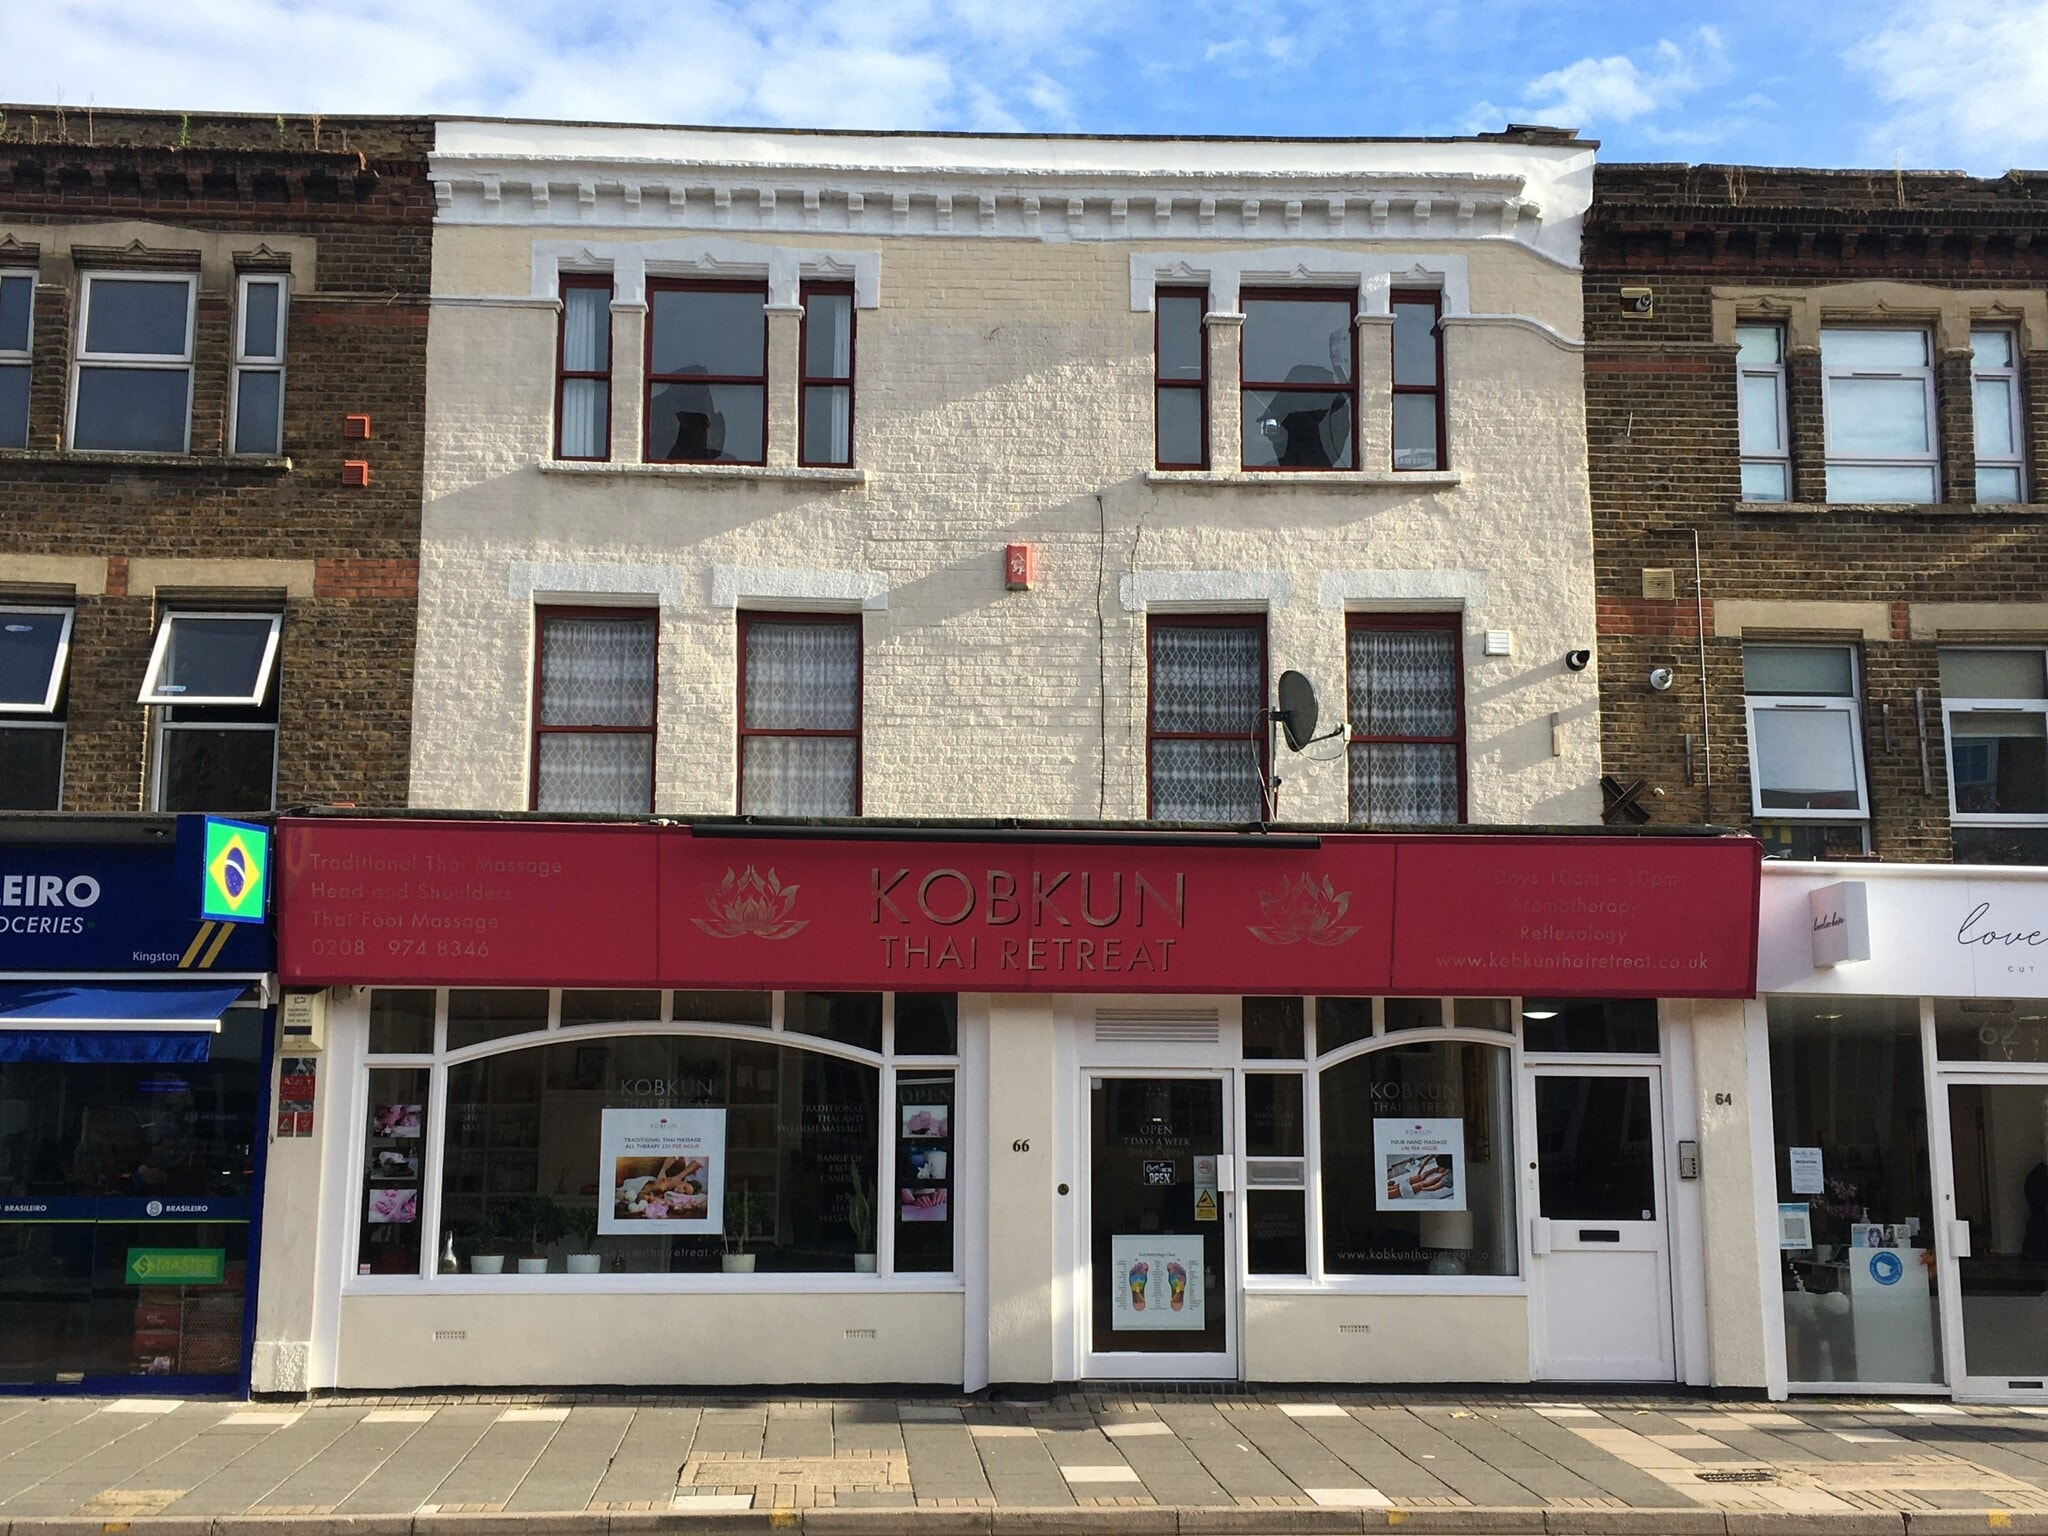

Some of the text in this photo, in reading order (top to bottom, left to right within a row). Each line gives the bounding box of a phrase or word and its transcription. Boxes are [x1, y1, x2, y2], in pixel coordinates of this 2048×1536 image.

[310, 853, 562, 878] Traditional Thai Massage
[0, 874, 101, 908] EIRO
[311, 882, 363, 899] Head
[372, 883, 408, 900] and
[871, 867, 1186, 929] KOBKUN
[312, 911, 499, 933] Thai Foot Massage
[1519, 924, 1628, 945] Reflexology
[132, 951, 180, 964] Kingston
[311, 939, 490, 958] 0208 974 8346
[879, 935, 1176, 972] THAI RETREAT
[2008, 965, 2036, 974] CUT
[620, 1078, 713, 1097] KOBKUN
[1370, 1081, 1459, 1099] KOBKUN
[1373, 1101, 1402, 1113] THAI
[1714, 1093, 1733, 1106] 64
[1140, 1124, 1173, 1136] OPEN
[1012, 1138, 1031, 1153] 66
[1149, 1172, 1171, 1184] OPEN
[4, 1204, 48, 1213] BRASILEIRO
[165, 1204, 209, 1213] BRASILEIRO
